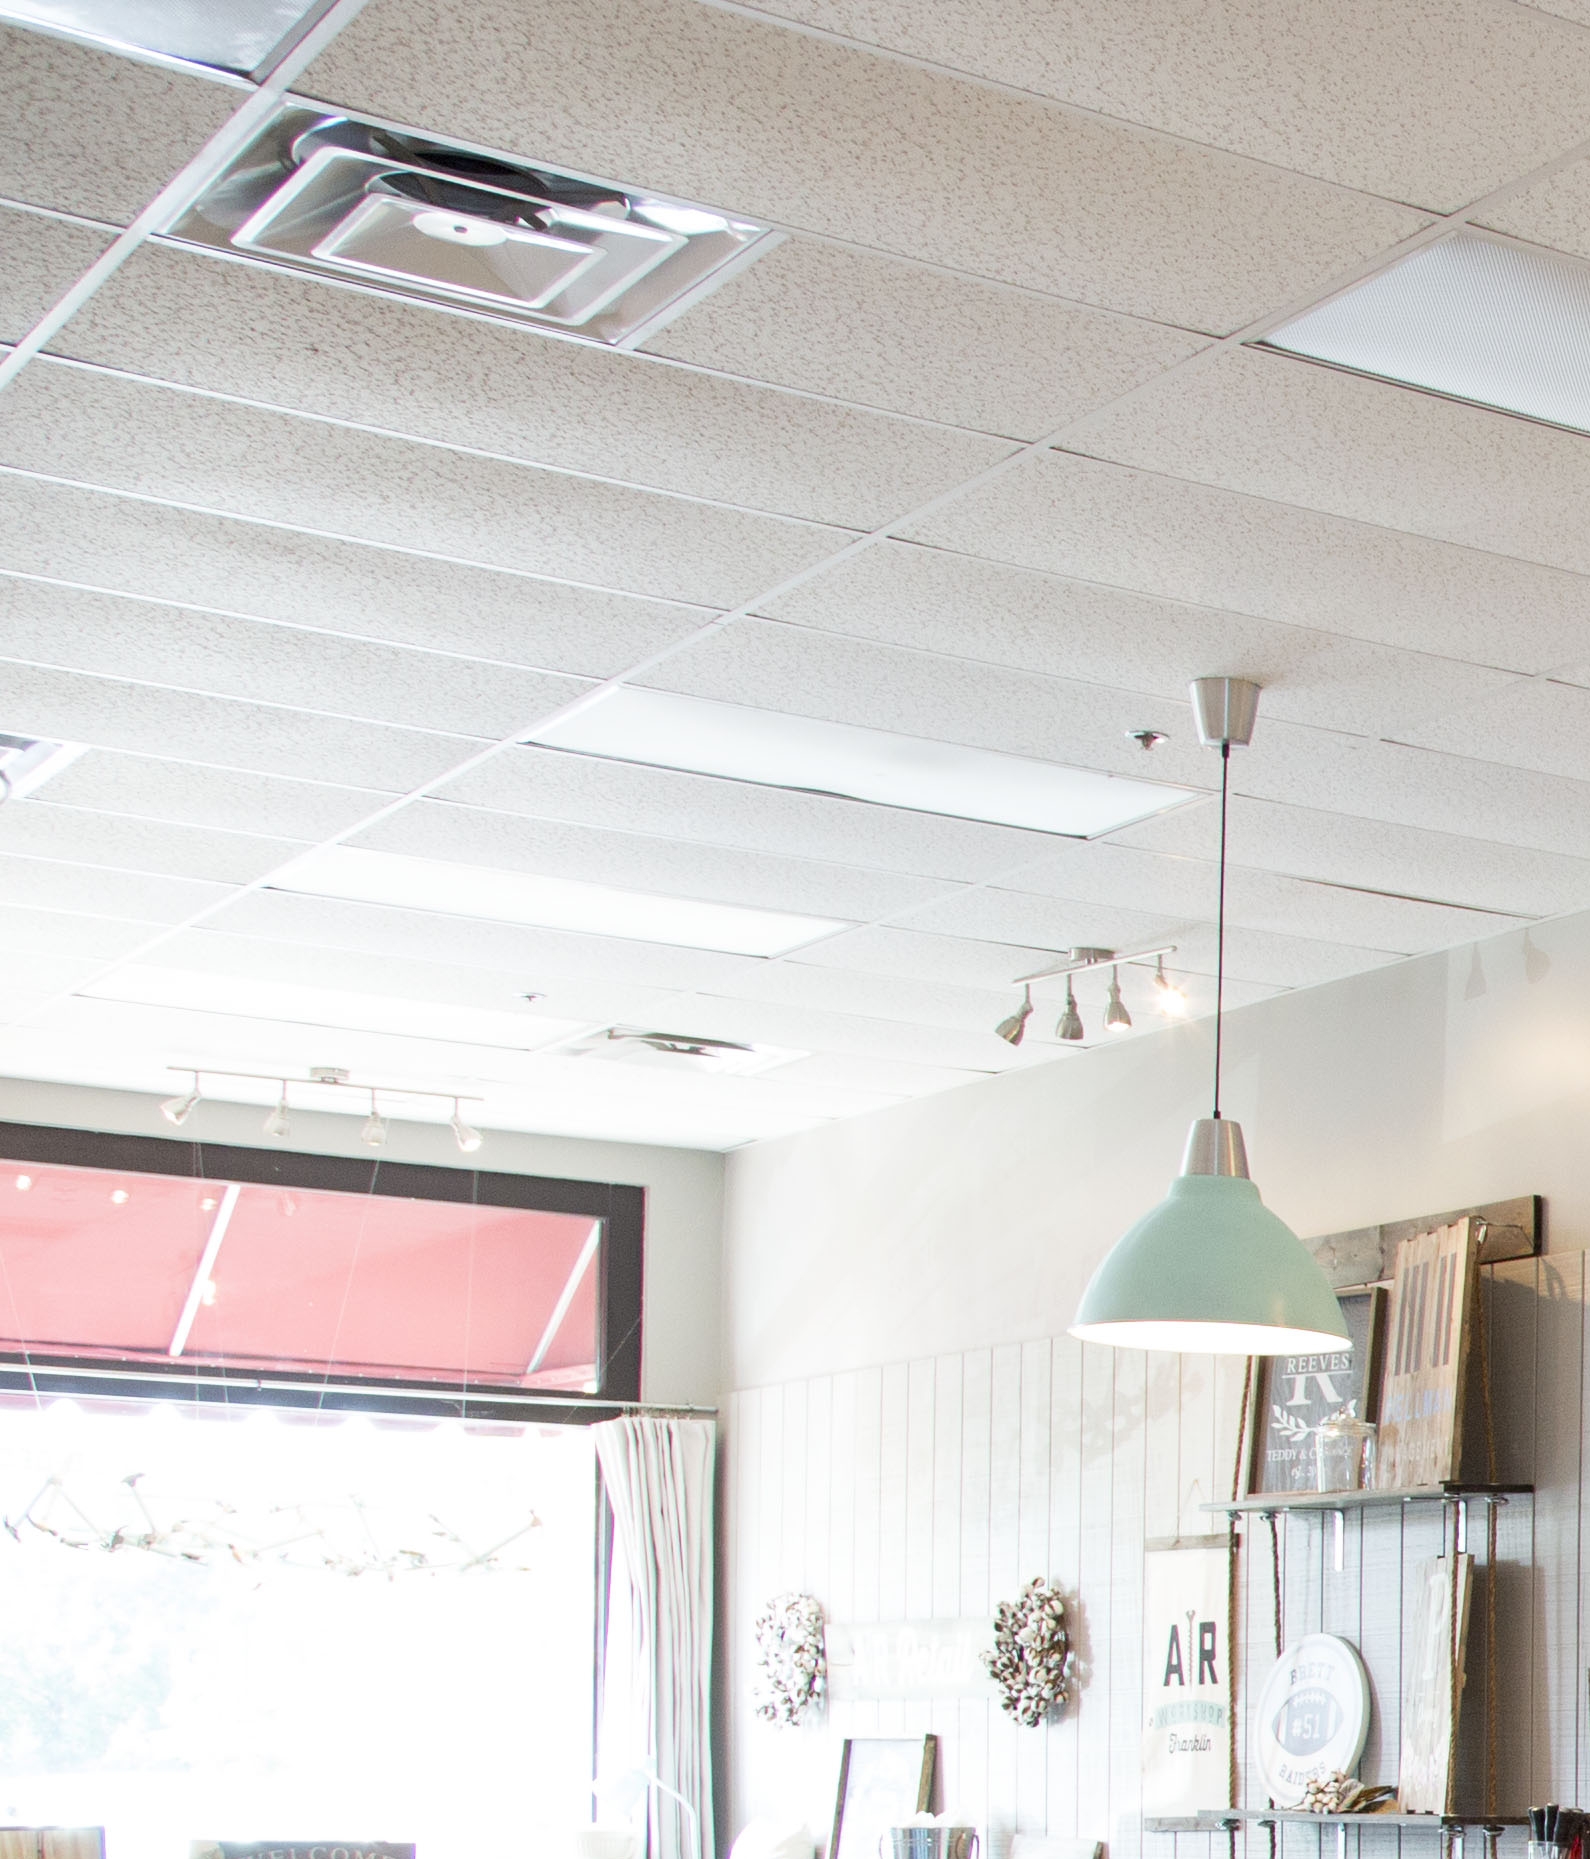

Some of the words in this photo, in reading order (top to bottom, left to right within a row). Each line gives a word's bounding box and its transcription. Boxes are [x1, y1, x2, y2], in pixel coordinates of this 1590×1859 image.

[1286, 1352, 1351, 1374] REEVES
[1289, 1661, 1336, 1686] BRETT
[1157, 1703, 1224, 1728] WORKSHOP
[1291, 1713, 1322, 1740] #51
[1168, 1733, 1212, 1754] Franklin
